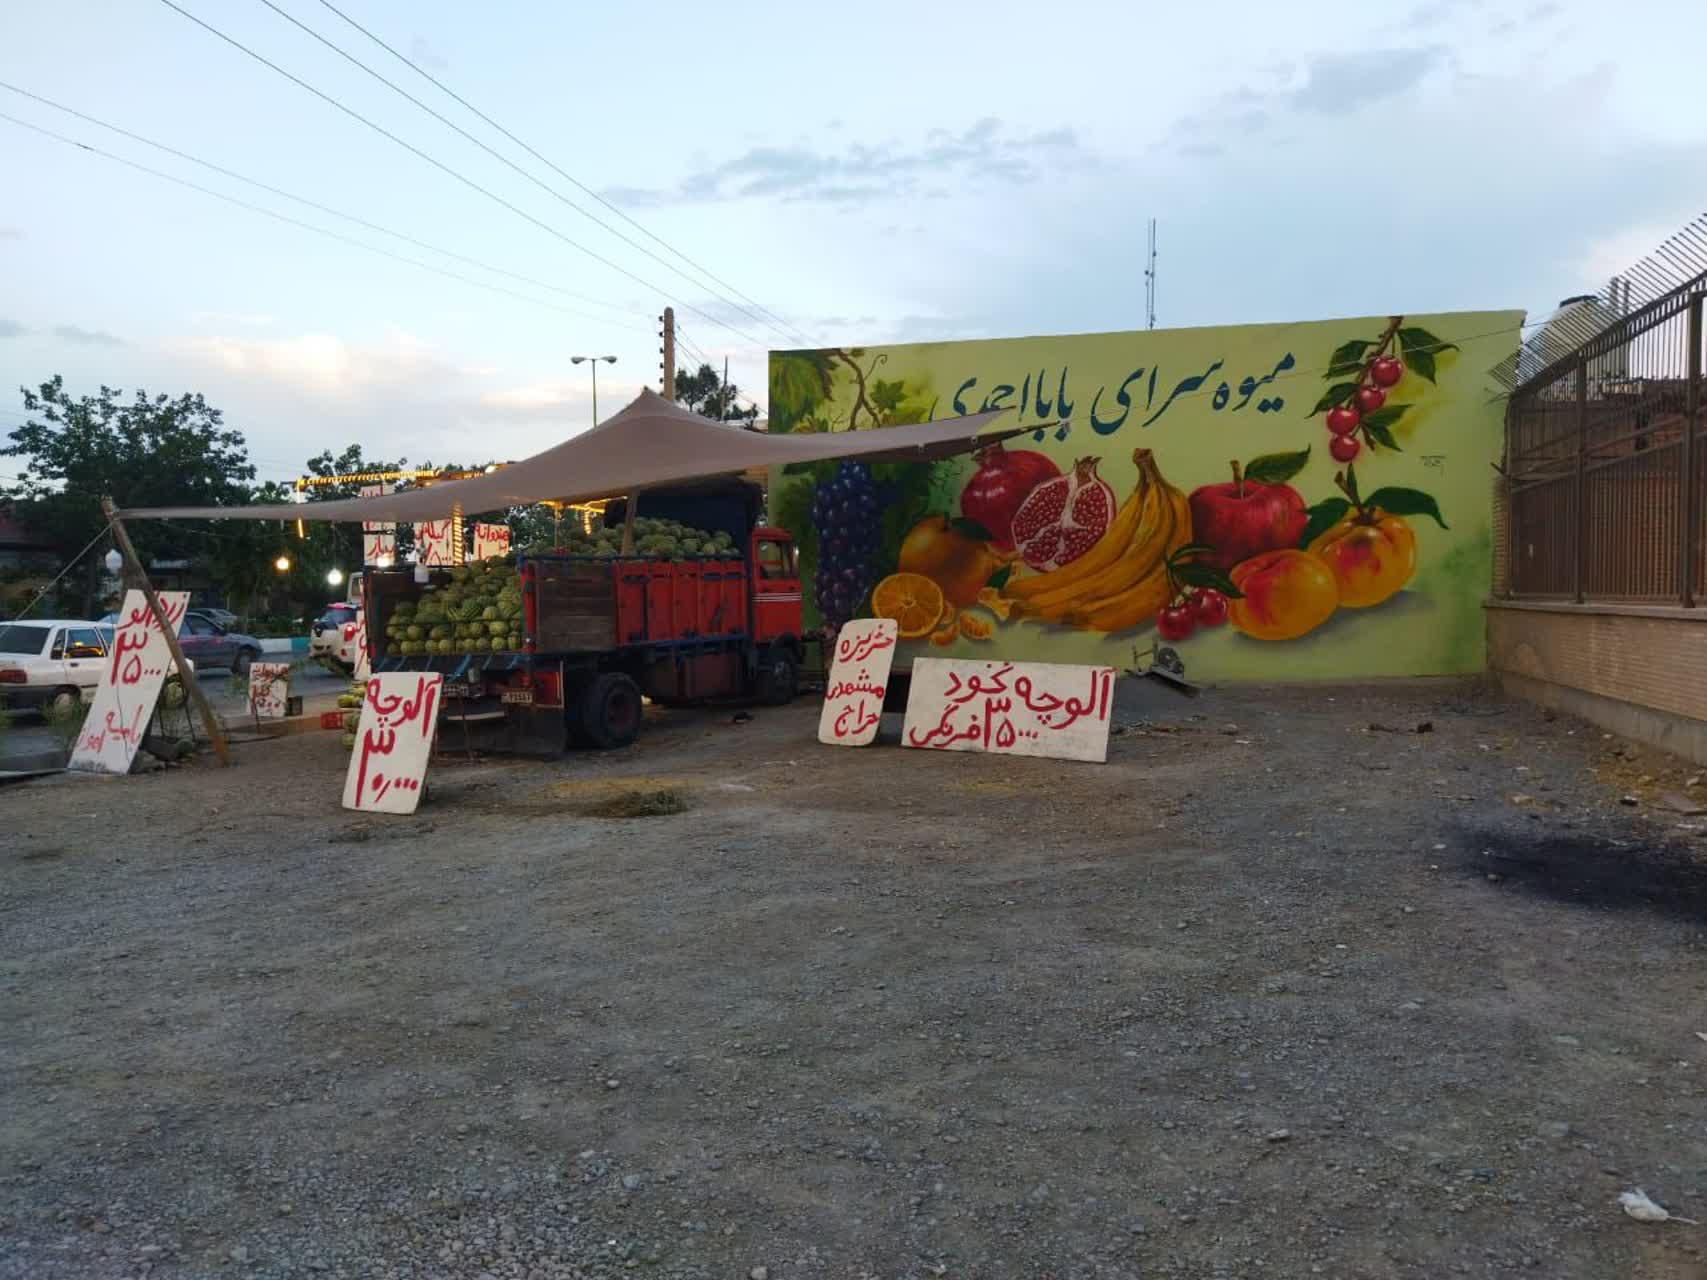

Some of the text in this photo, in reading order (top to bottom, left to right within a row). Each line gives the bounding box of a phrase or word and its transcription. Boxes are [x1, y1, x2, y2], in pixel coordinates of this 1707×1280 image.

[1034, 366, 1074, 442] بابا
[1090, 358, 1224, 436] سرای
[1212, 352, 1295, 414] میوه
[839, 624, 894, 663] خربزه
[366, 675, 443, 737] آلوچه
[825, 669, 885, 700] مشهدی
[944, 662, 1119, 730] آلوچه نخود
[834, 699, 879, 737] حراج
